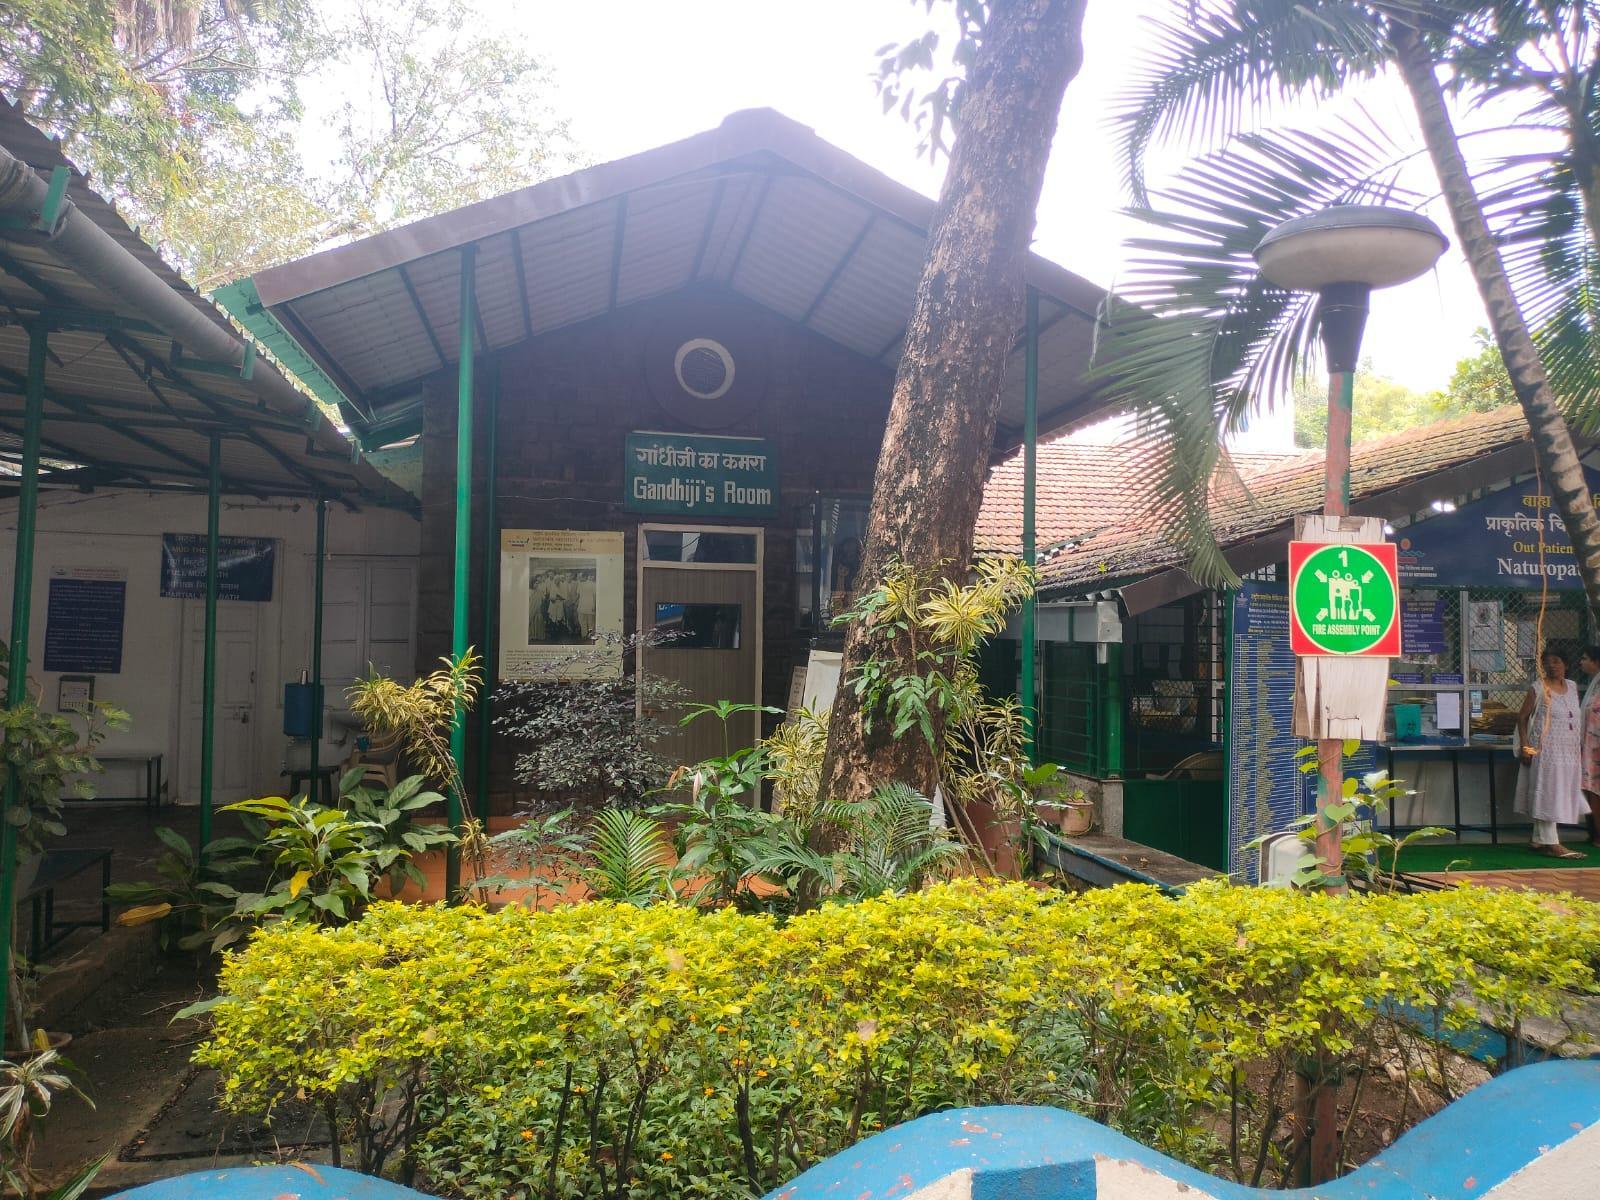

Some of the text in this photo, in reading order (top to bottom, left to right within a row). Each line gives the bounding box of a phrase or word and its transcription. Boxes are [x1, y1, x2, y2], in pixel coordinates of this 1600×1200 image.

[635, 443, 767, 472] गांधीजी का कमरा
[633, 476, 771, 508] Gandhiji's Room
[1485, 512, 1545, 537] प्राकृतिक
[1513, 541, 1574, 554] Out Patien
[1338, 550, 1348, 567] 1
[1312, 624, 1381, 636] FIRE ASSEMBLY POINT
